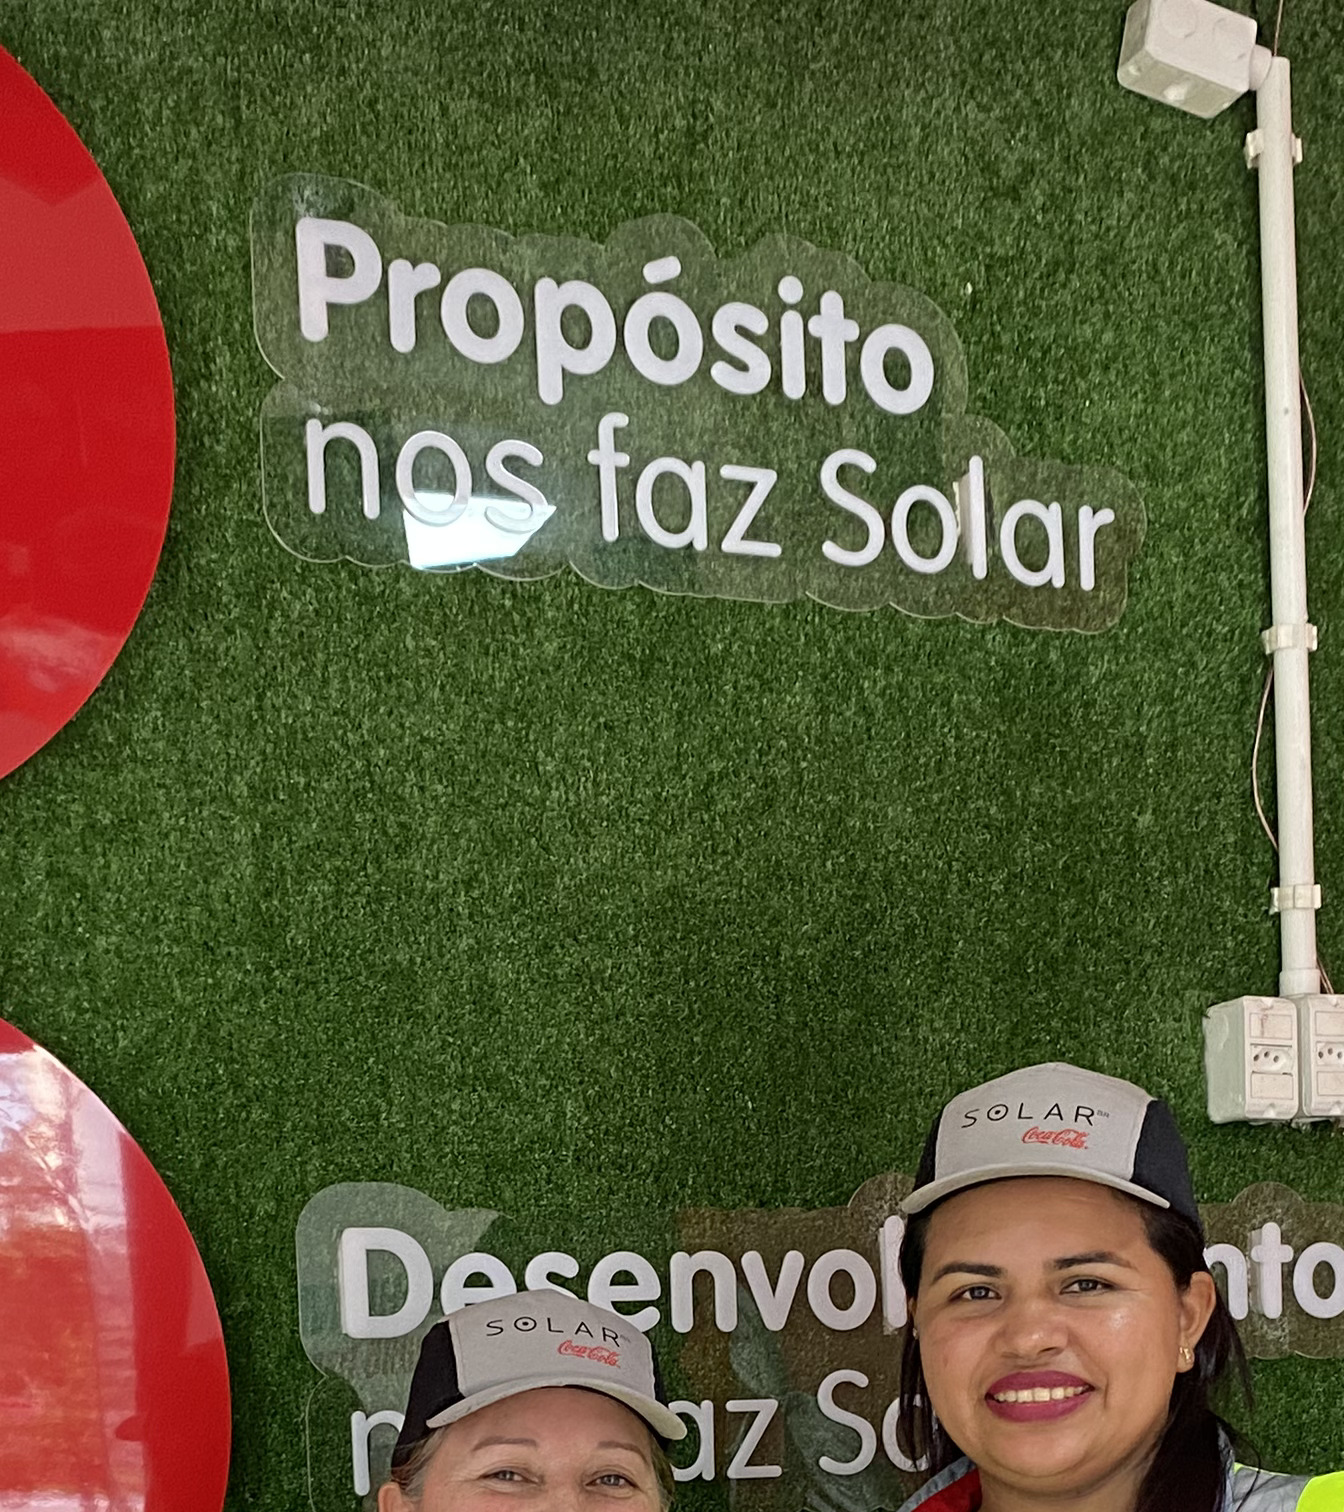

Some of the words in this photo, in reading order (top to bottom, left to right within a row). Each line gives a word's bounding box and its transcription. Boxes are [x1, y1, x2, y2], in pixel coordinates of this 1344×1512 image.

[294, 215, 935, 415] Propósito
[306, 417, 549, 534] nos
[587, 412, 783, 558] faz
[820, 448, 1117, 592] Solar
[961, 1103, 1093, 1128] SOLAR
[1022, 1126, 1089, 1149] Coca-Cola
[486, 1316, 620, 1347] SOLAR
[558, 1340, 621, 1368] Coca-Cola
[666, 1399, 783, 1482] az
